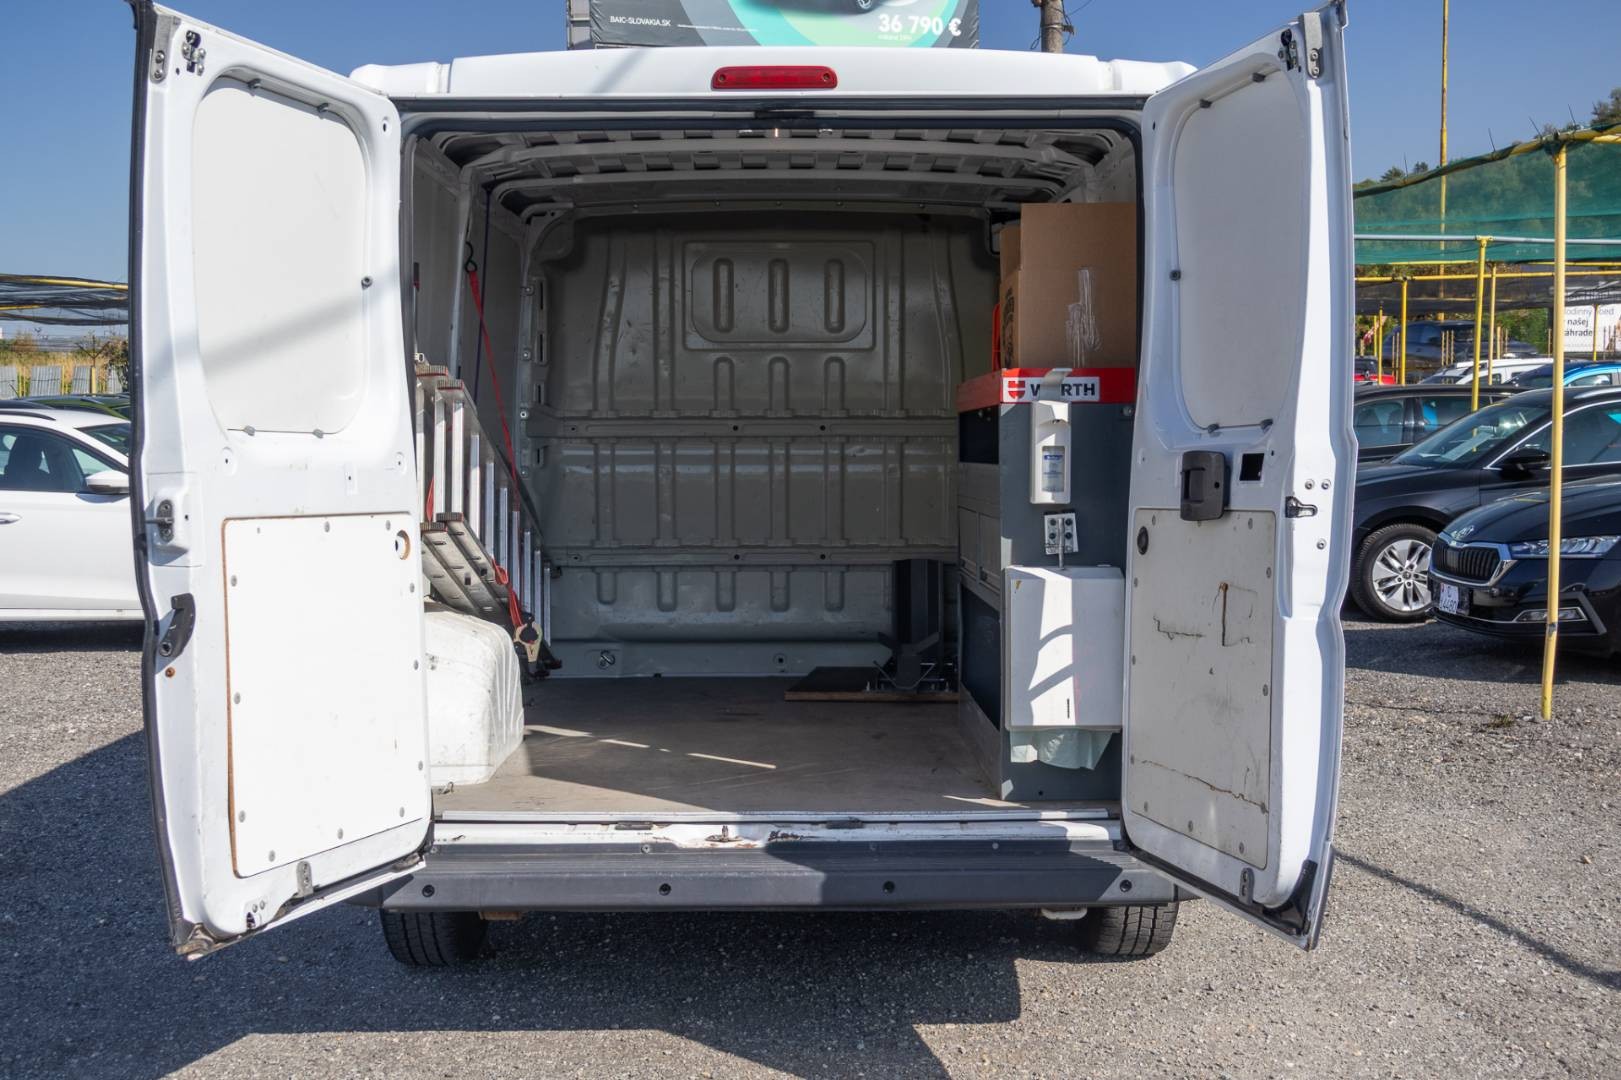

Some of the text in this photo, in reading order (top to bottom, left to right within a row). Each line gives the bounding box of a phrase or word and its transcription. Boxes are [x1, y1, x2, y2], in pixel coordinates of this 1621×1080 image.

[610, 15, 671, 27] BAIC-SLOVAKIA.SK
[878, 13, 962, 37] 36 790 €
[1564, 328, 1592, 336] áhrade
[1030, 383, 1095, 396] WRTH
